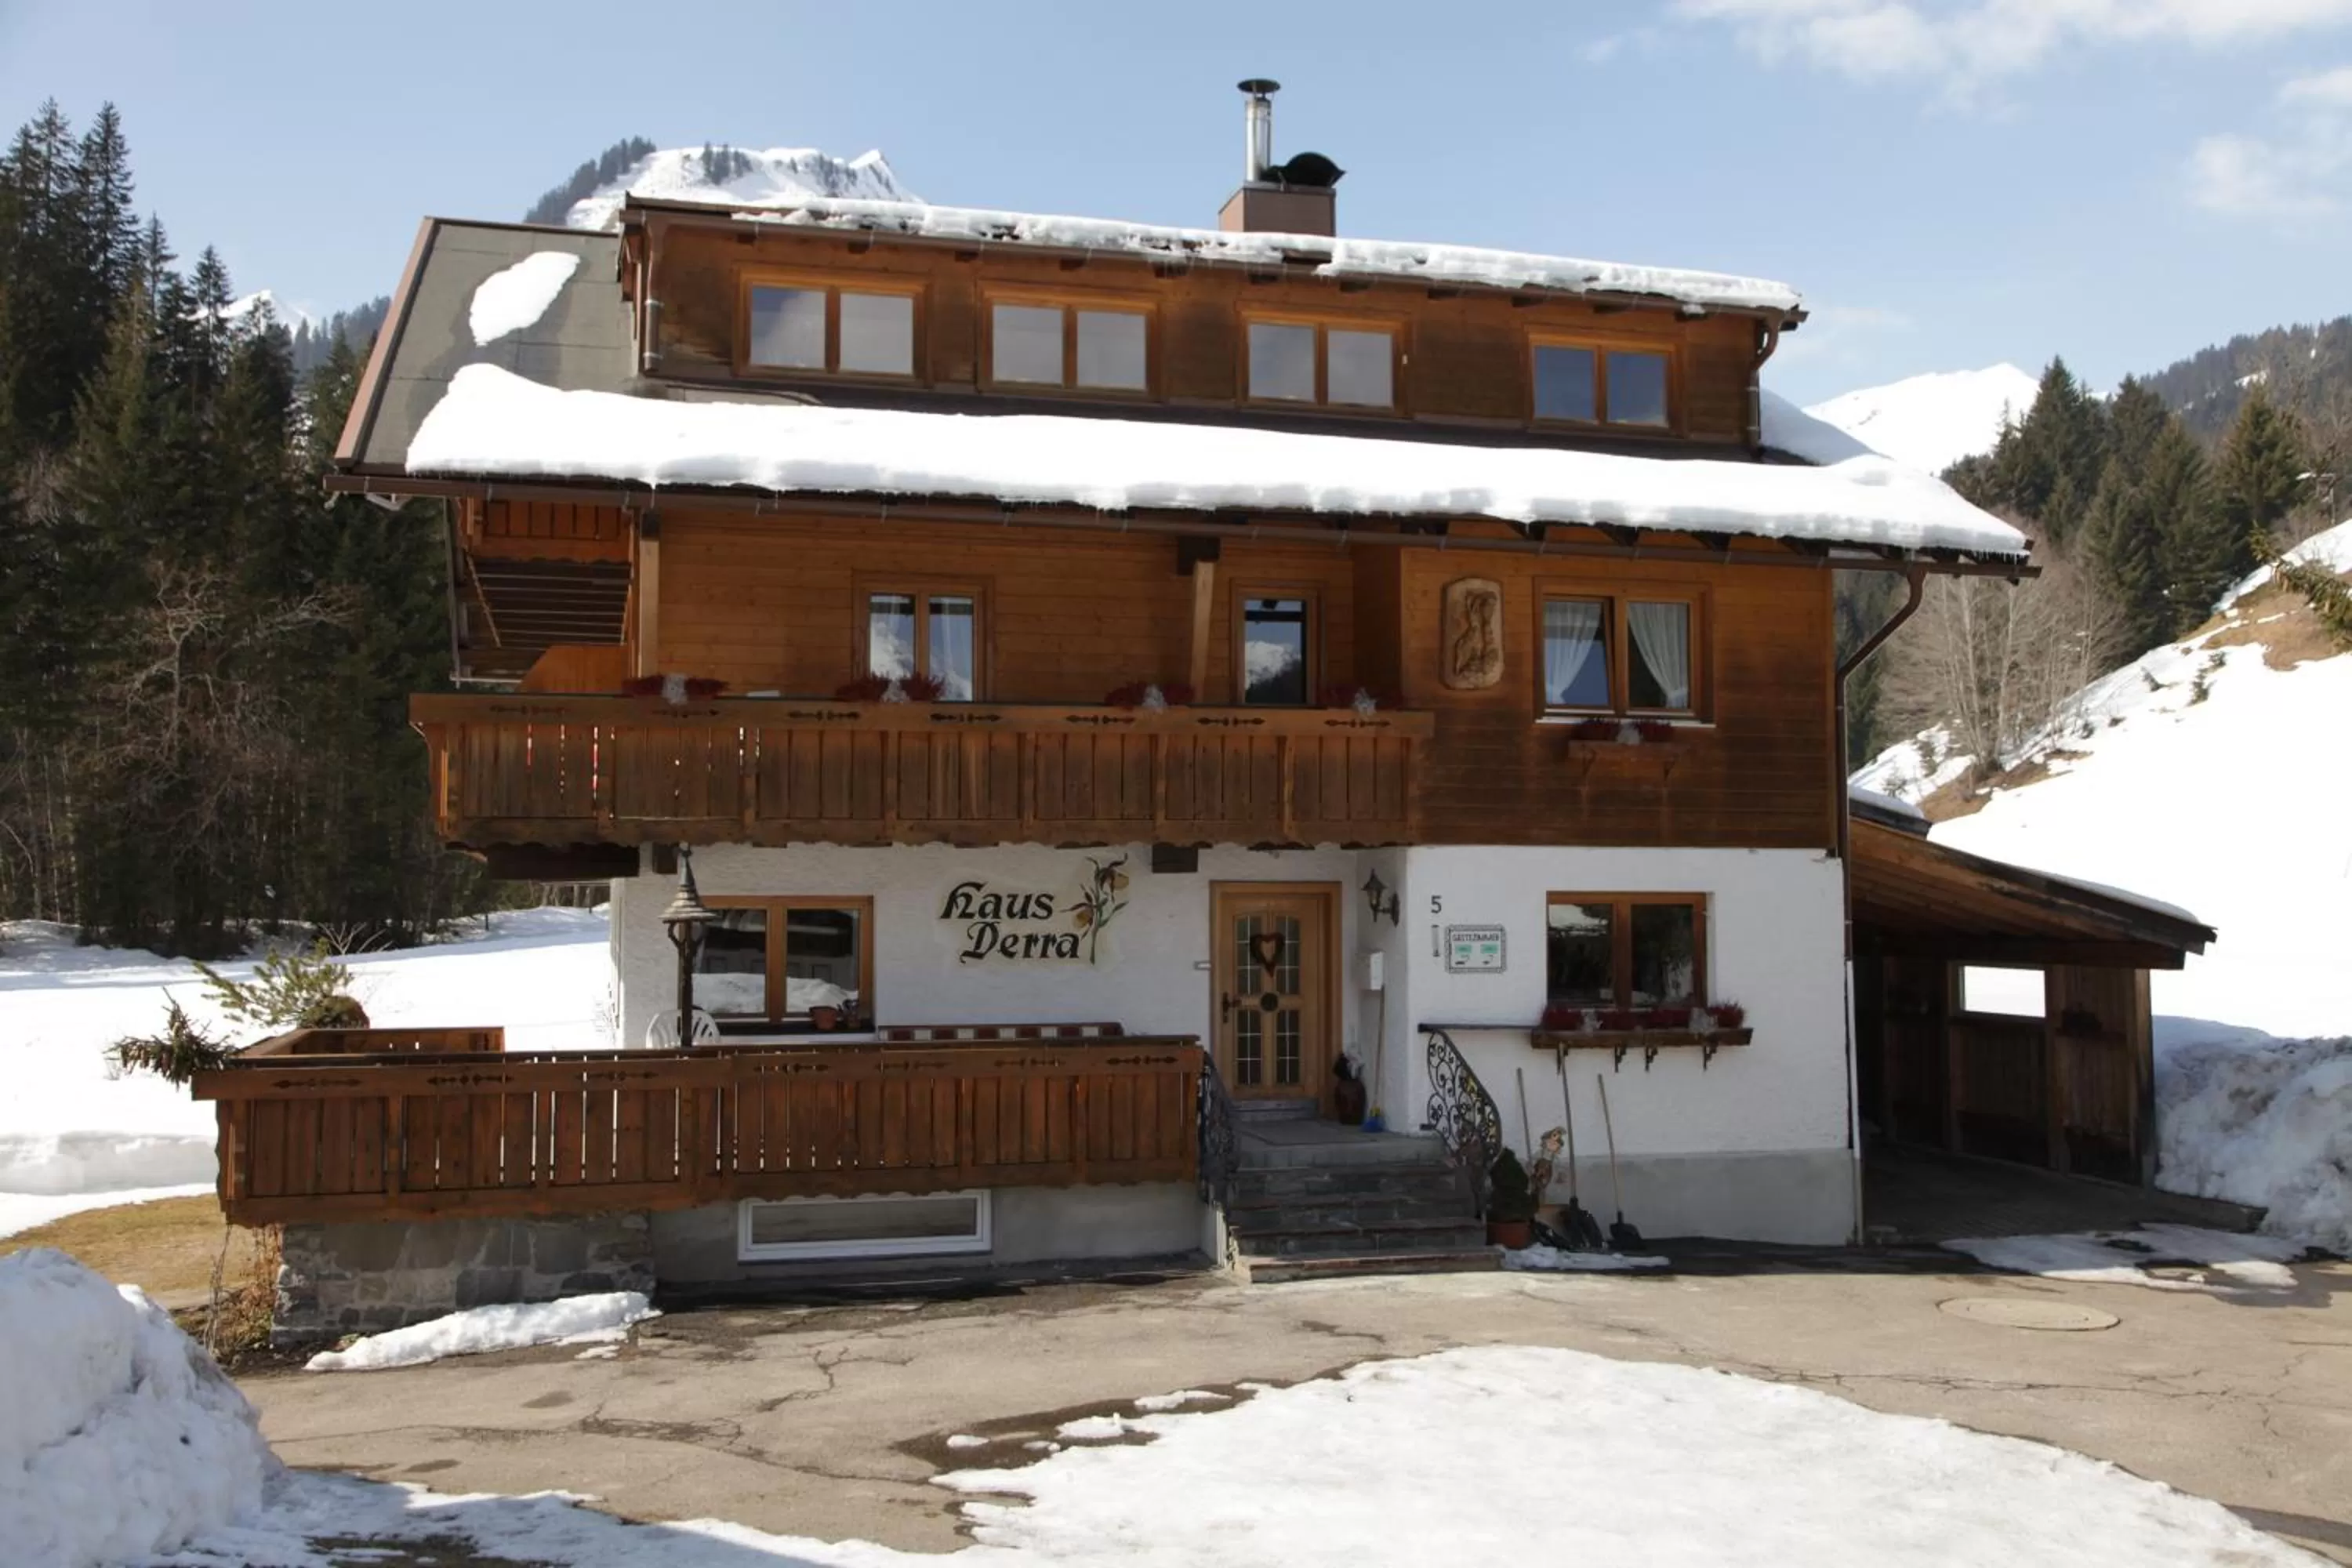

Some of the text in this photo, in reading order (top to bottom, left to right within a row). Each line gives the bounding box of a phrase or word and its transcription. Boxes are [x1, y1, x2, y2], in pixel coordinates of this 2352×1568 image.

[940, 881, 1054, 920] Haus
[1431, 895, 1442, 913] 5
[960, 921, 1080, 964] Derra
